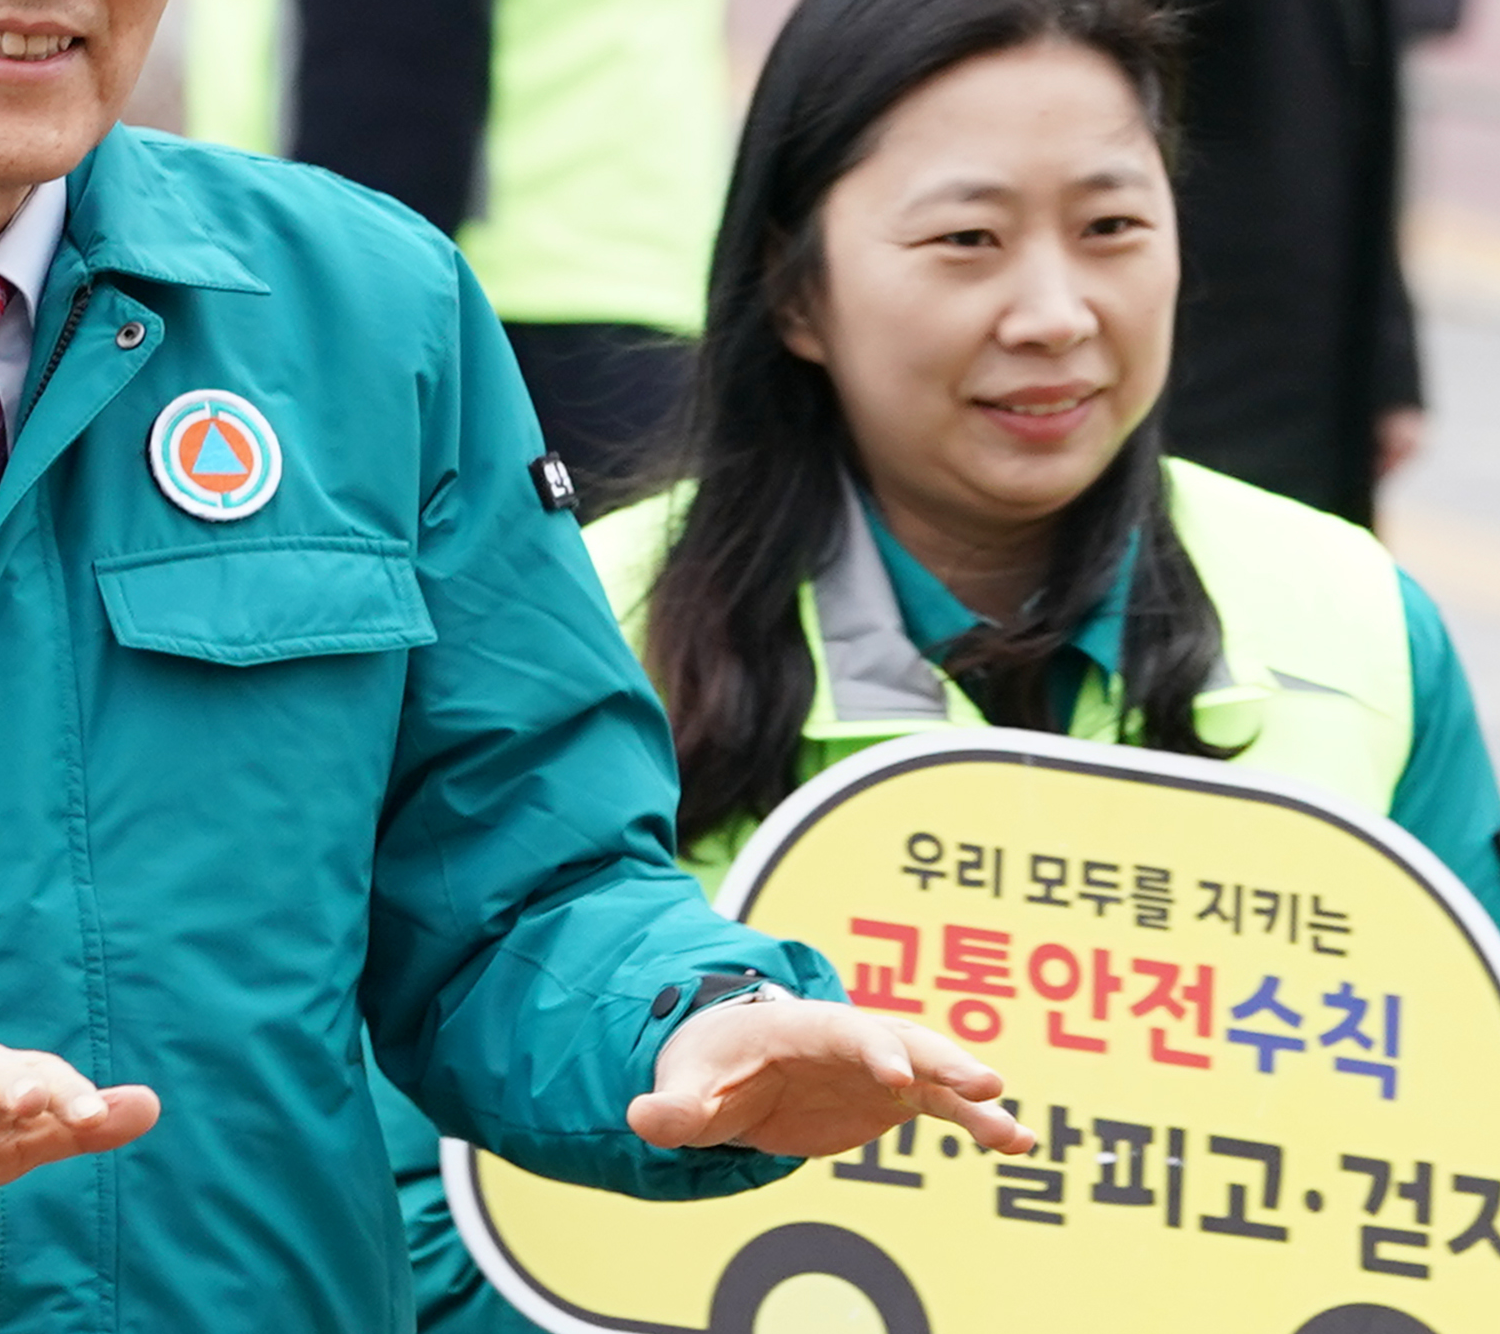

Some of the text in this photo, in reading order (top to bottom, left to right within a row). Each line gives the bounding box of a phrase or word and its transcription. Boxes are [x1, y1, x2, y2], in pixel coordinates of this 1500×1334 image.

[901, 831, 1353, 958] 우리 모두를 지키는
[848, 916, 1402, 1102] 교통안전수칙
